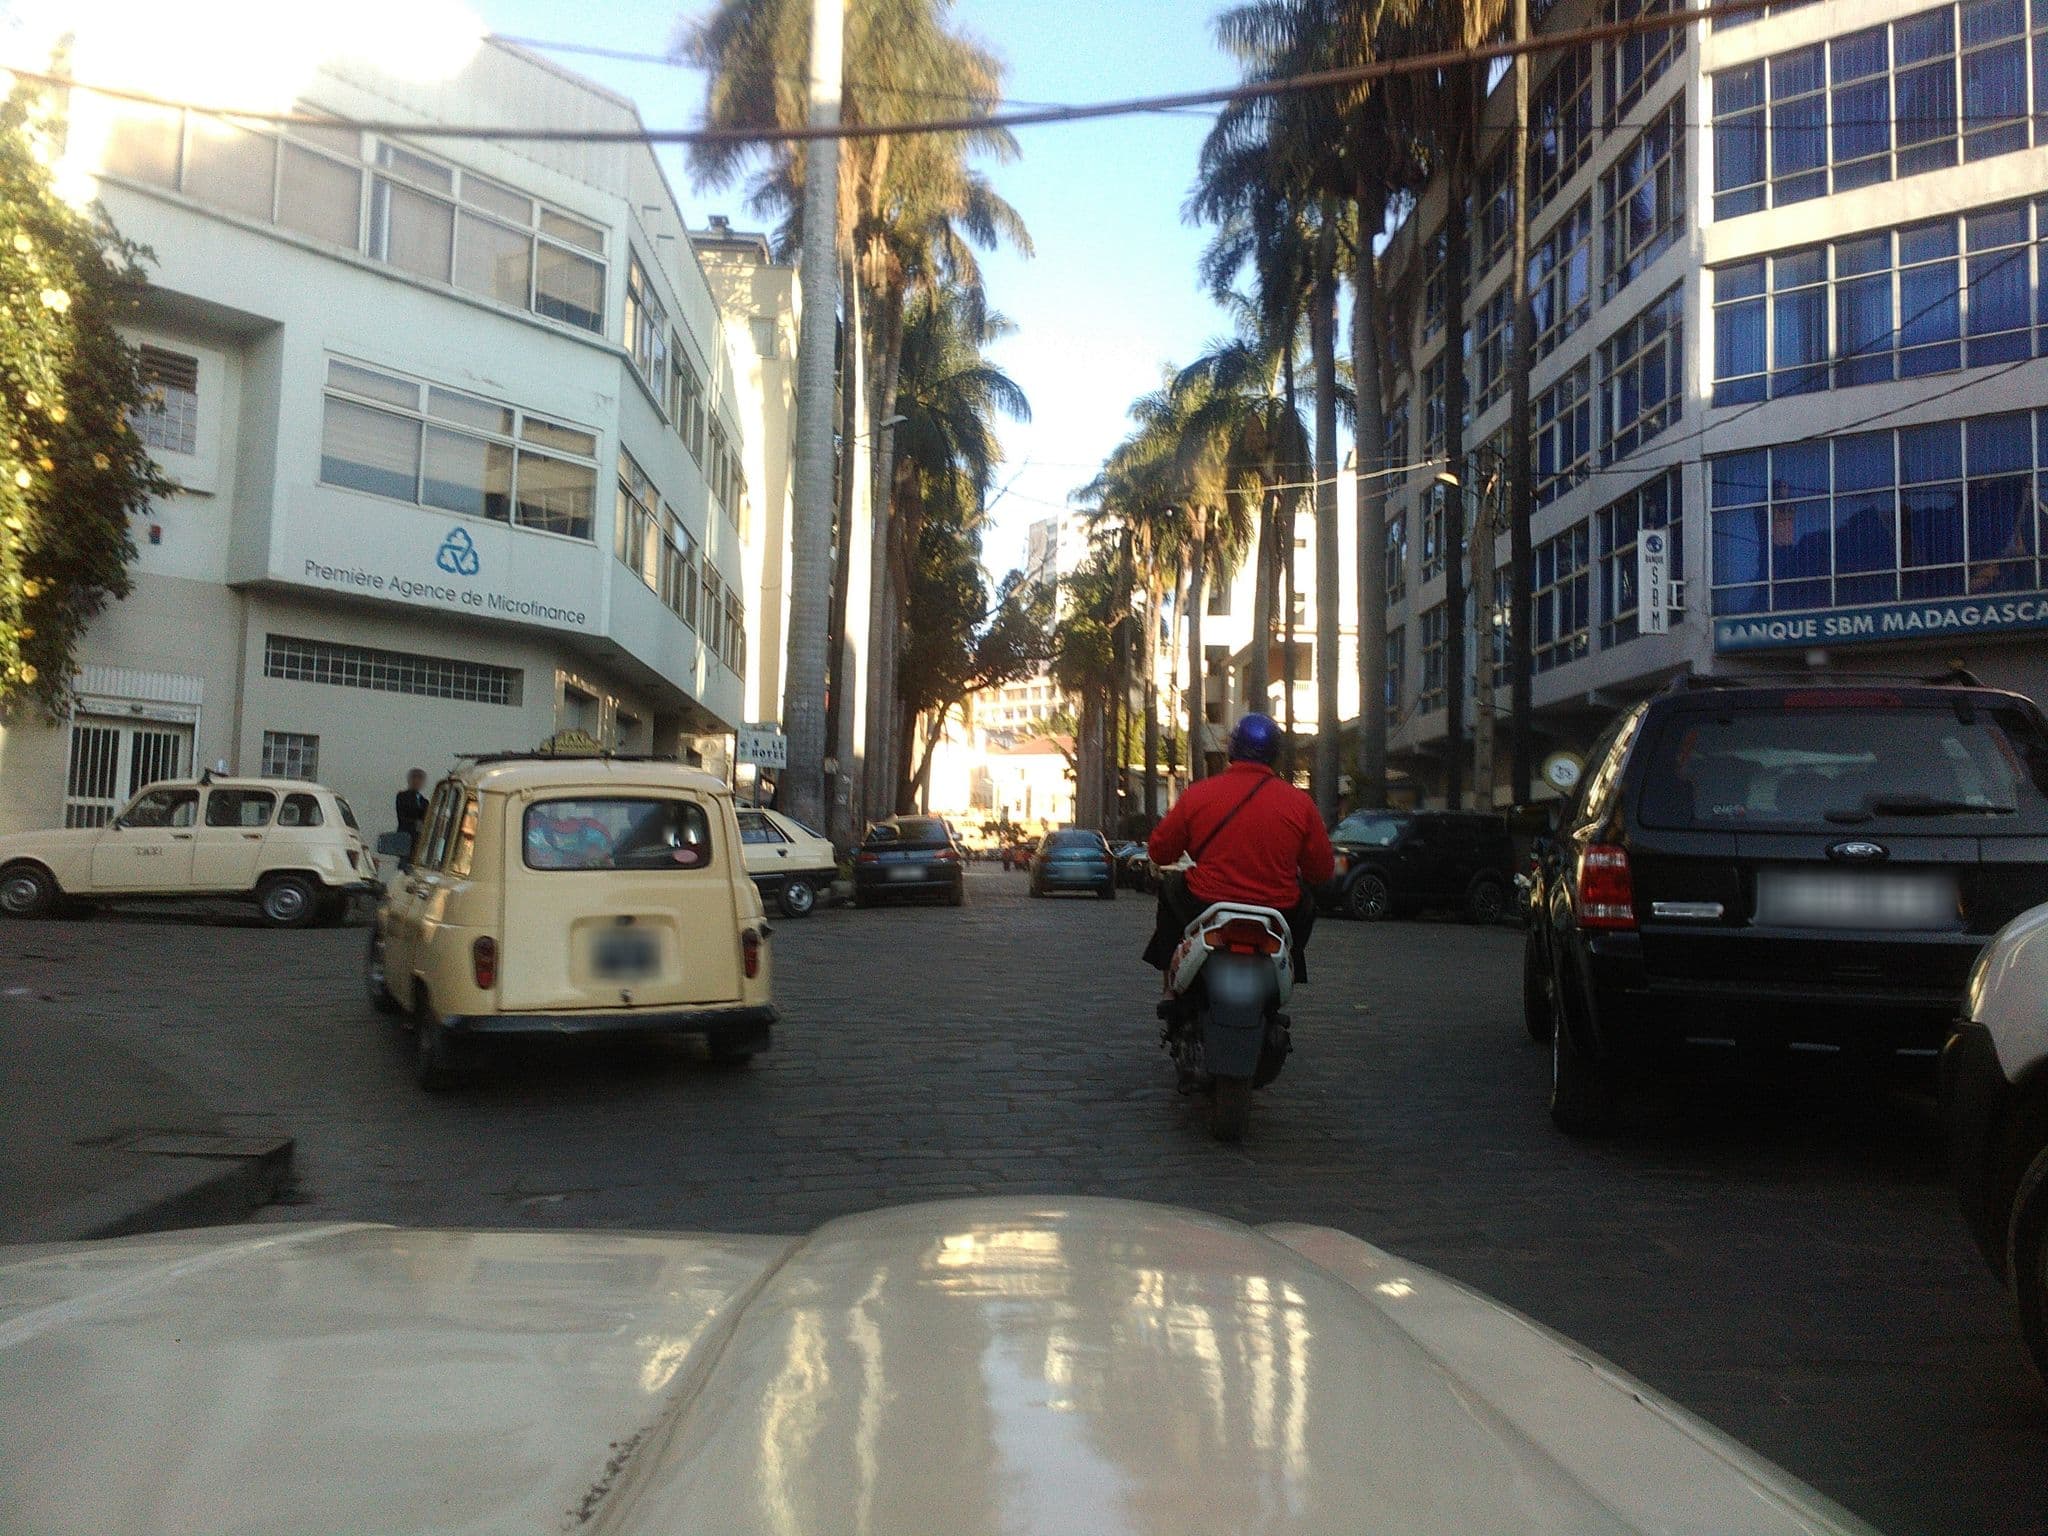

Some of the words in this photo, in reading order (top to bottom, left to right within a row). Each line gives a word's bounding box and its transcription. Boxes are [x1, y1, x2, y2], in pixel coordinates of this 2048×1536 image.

[304, 559, 384, 589] Première
[388, 575, 456, 601] Agence
[461, 589, 483, 606] de
[487, 592, 586, 625] Microfinance
[1824, 615, 1875, 637] SBM
[752, 748, 785, 760] HOTEL
